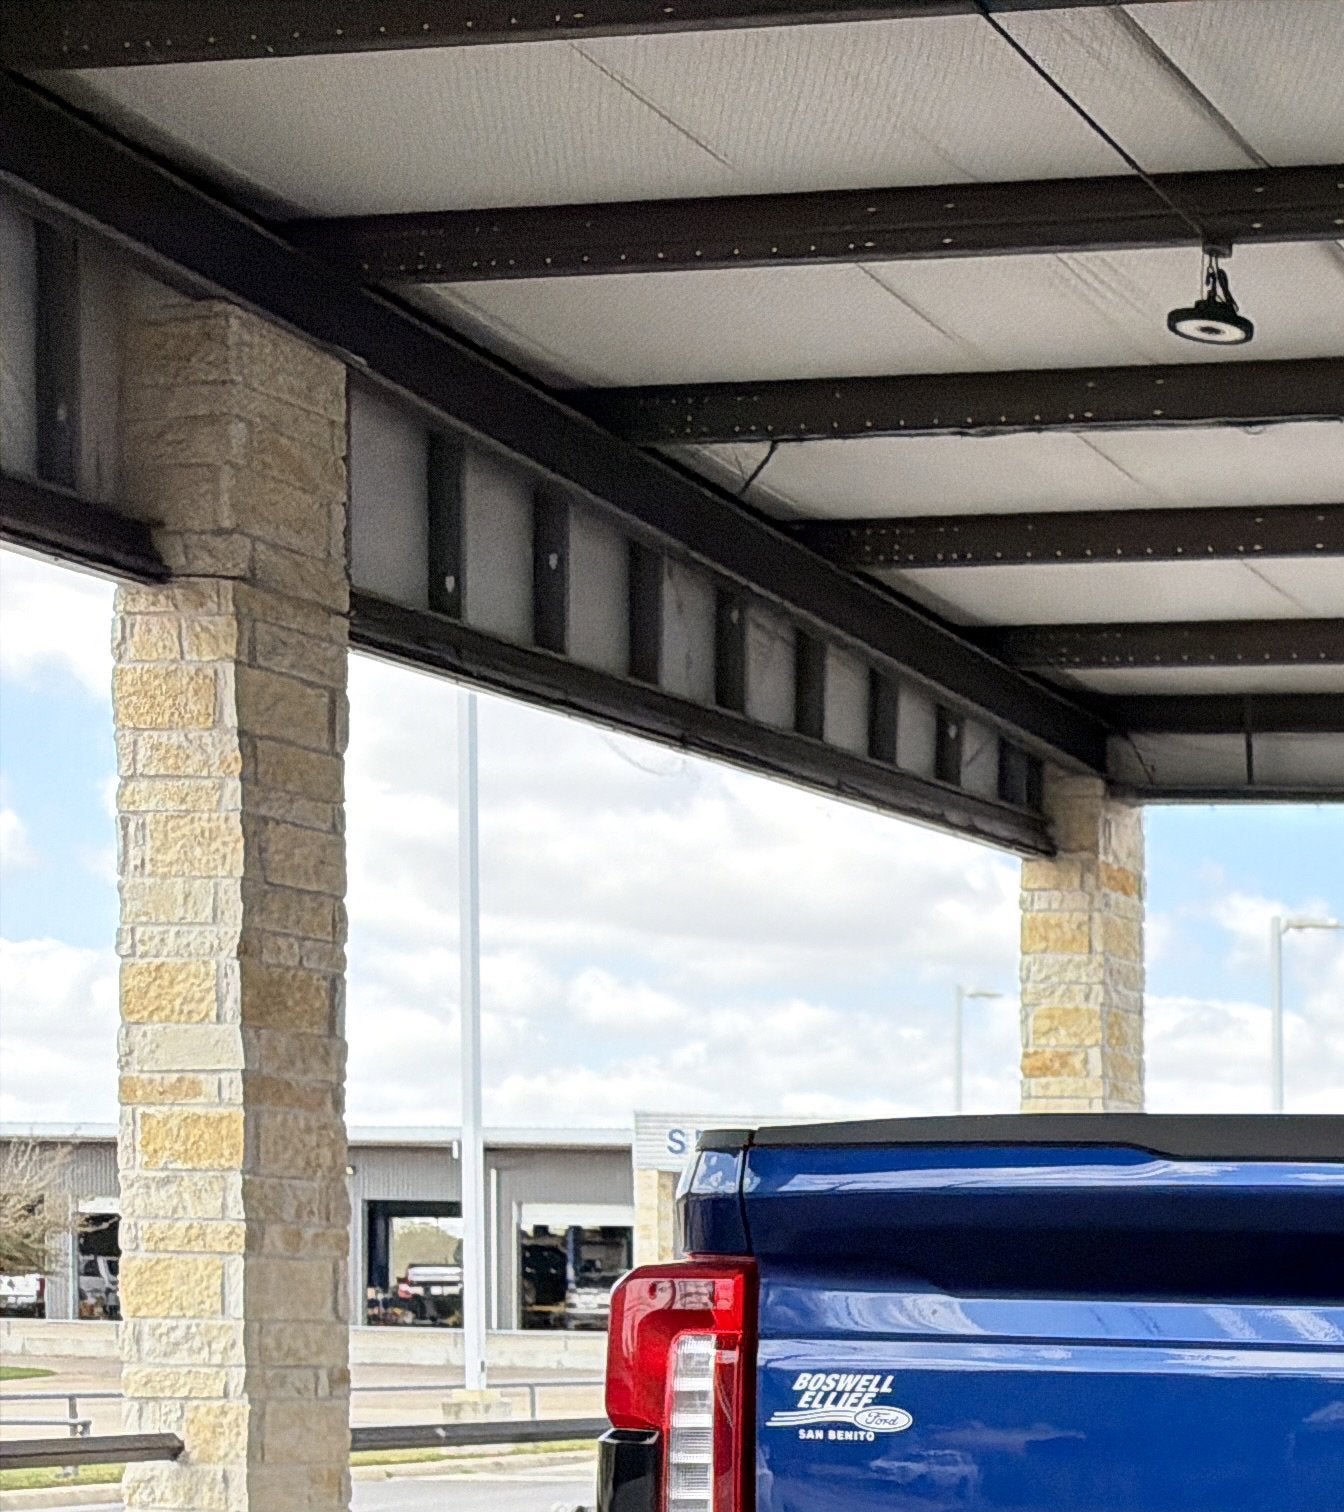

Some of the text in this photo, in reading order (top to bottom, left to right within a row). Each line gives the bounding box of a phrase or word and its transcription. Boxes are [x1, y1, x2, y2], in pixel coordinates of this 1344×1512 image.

[792, 1373, 894, 1393] BOSWELL
[797, 1392, 876, 1410] ELLIFF
[864, 1410, 899, 1426] Ford
[798, 1429, 875, 1441] SAN BENITO
